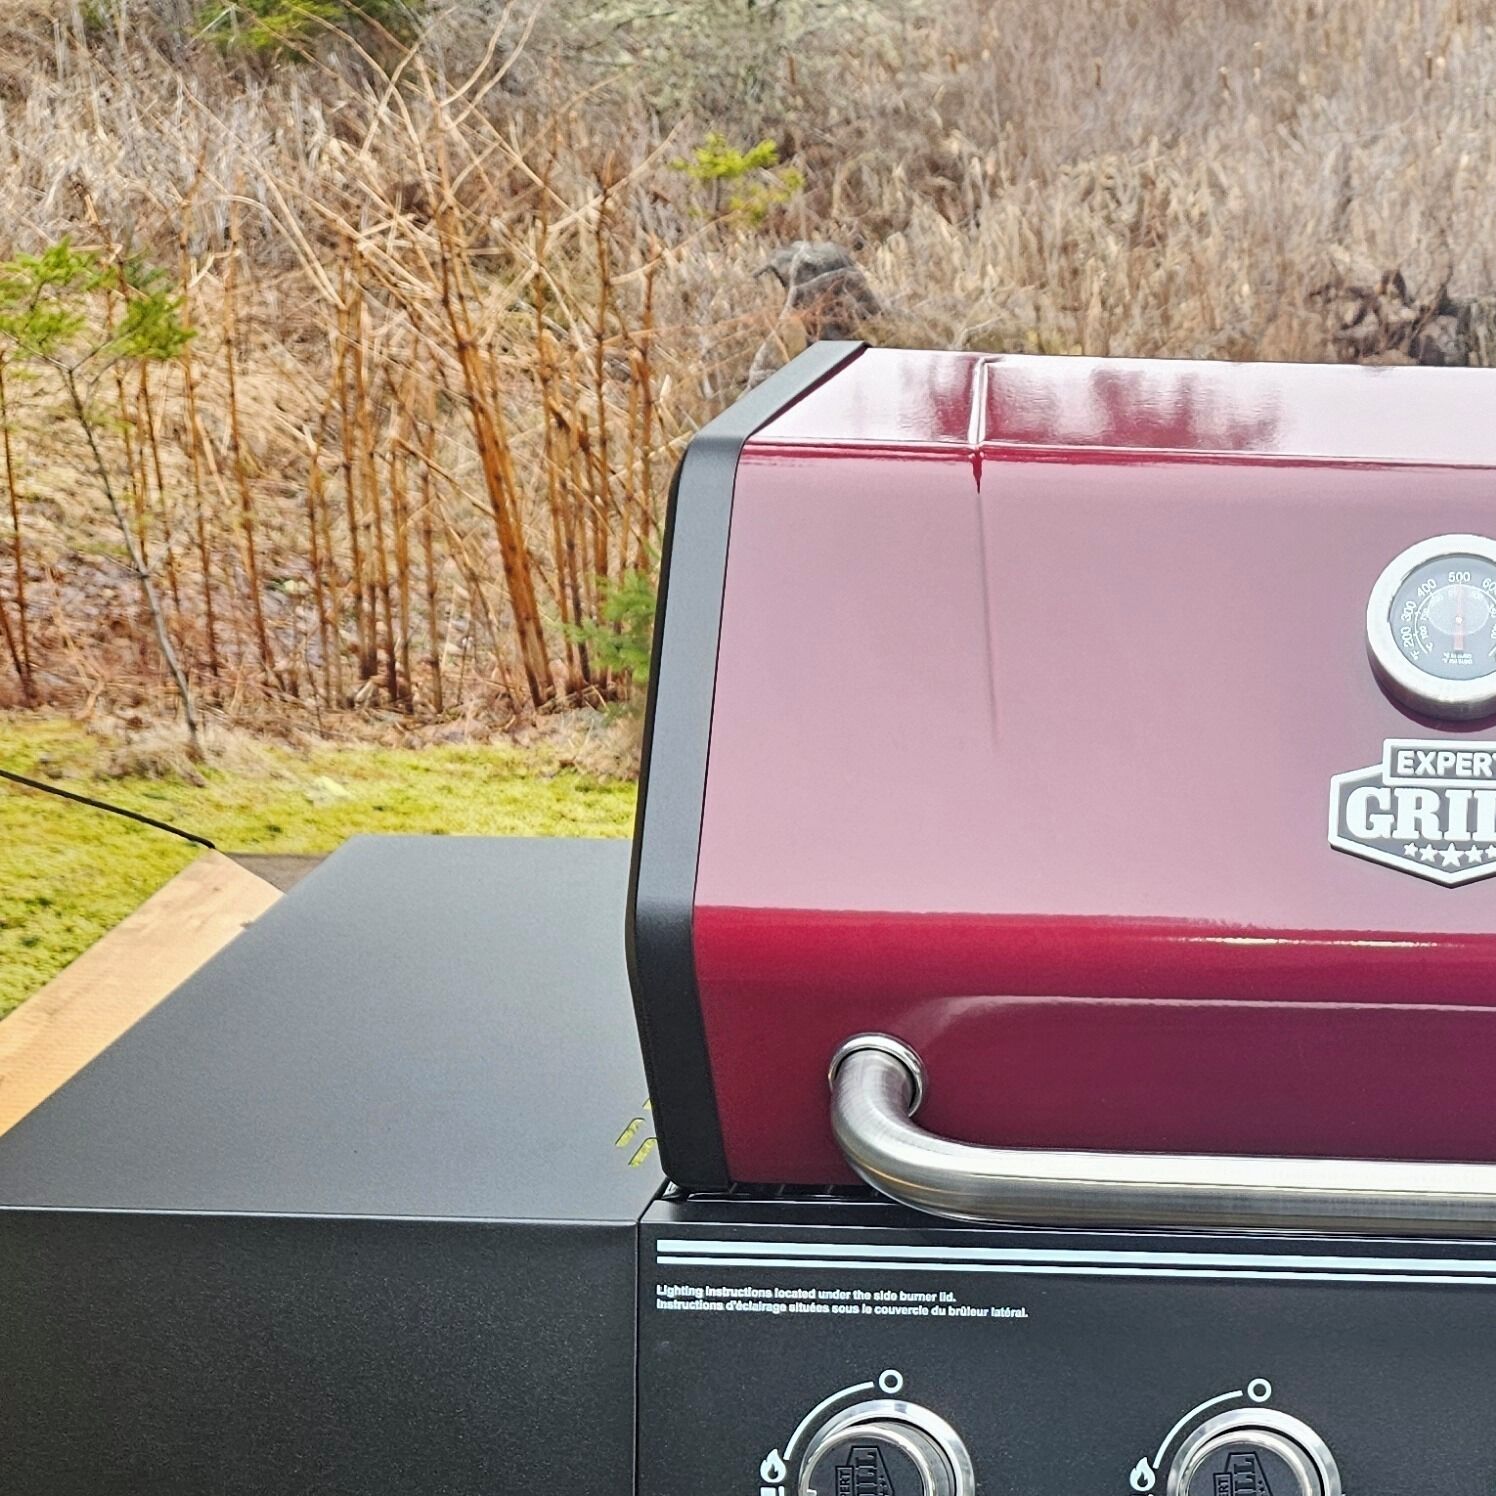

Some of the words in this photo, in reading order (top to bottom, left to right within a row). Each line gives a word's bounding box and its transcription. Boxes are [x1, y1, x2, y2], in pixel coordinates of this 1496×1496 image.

[1448, 572, 1471, 583] 500
[1417, 578, 1437, 597] 400
[1400, 600, 1417, 622] 300
[1400, 626, 1414, 648] 200
[656, 1284, 704, 1298] Lighting
[774, 1287, 816, 1300] located
[818, 1289, 851, 1300] under
[853, 1290, 871, 1301] the
[873, 1290, 898, 1301] side
[899, 1291, 937, 1302] burner
[939, 1291, 957, 1302] lid.
[726, 1300, 787, 1314] d'éclairage
[788, 1301, 830, 1314] situées
[832, 1304, 860, 1315] sous
[862, 1303, 872, 1314] le
[874, 1304, 929, 1316] couvercle
[930, 1305, 946, 1316] du
[948, 1305, 989, 1317] brûleur
[991, 1306, 1029, 1318] latéral.
